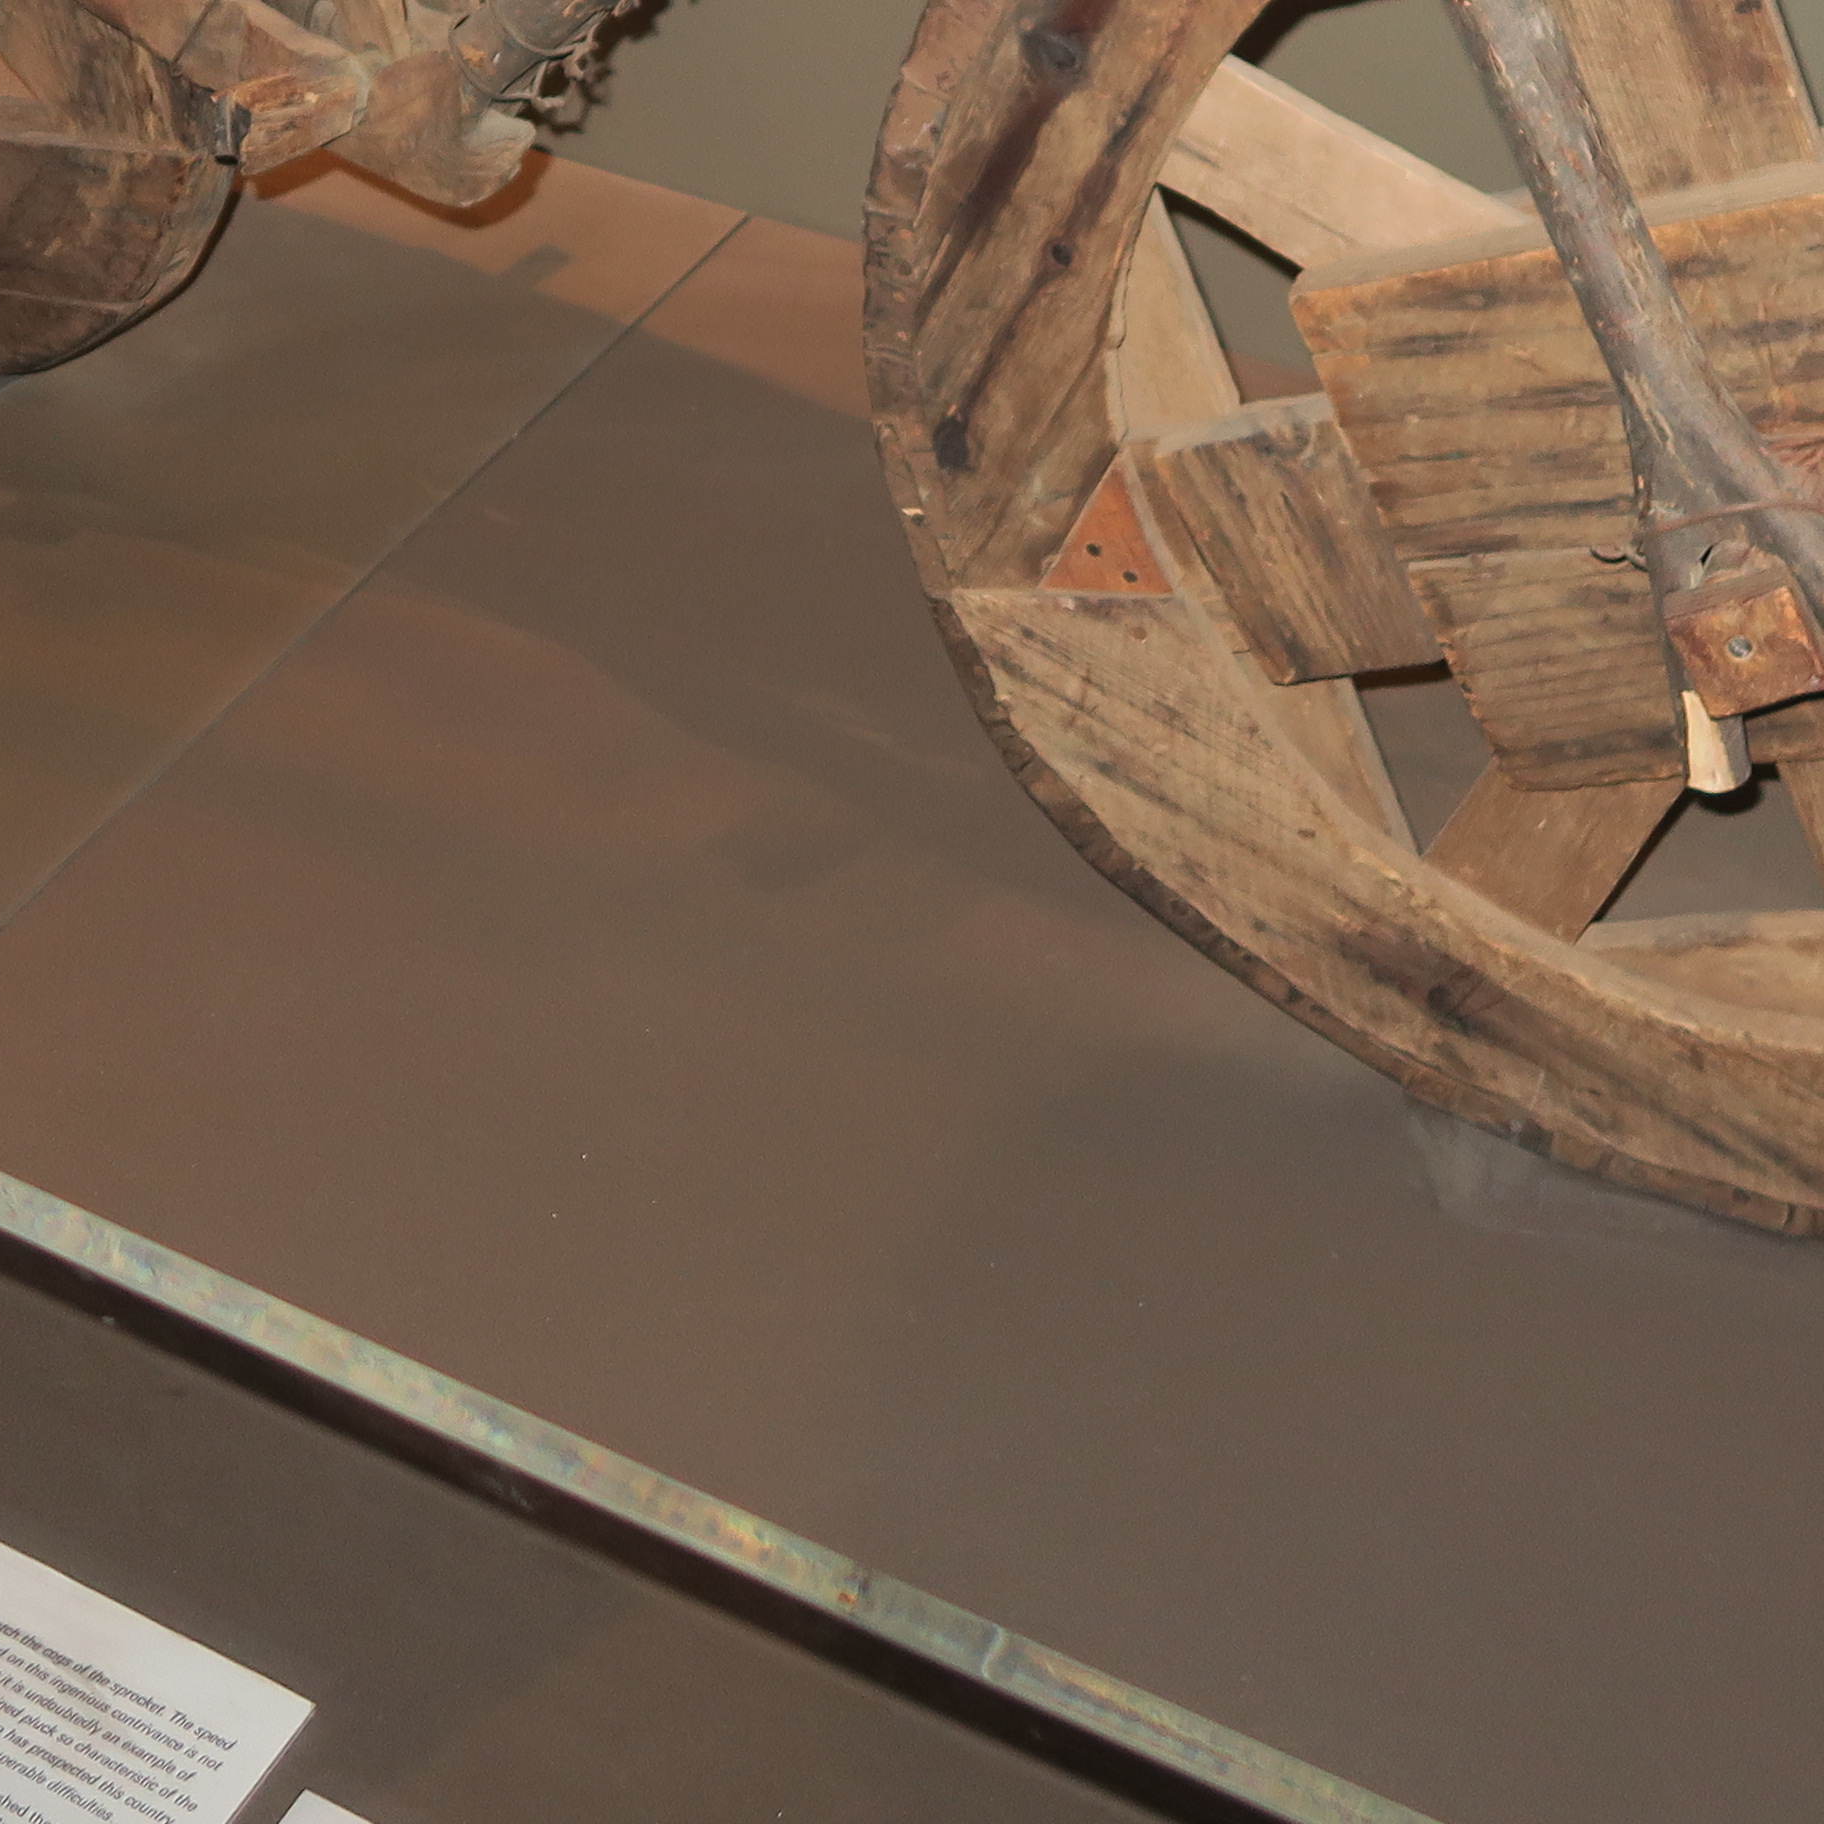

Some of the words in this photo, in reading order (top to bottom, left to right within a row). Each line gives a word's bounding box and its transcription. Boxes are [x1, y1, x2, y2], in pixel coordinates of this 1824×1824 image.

[5, 1654, 24, 1667] on
[23, 1662, 49, 1681] this
[49, 1677, 110, 1712] ingenious
[110, 1709, 183, 1751] contrivance
[183, 1747, 198, 1758] is
[196, 1754, 223, 1771] not
[10, 1680, 25, 1693] is
[24, 1690, 102, 1735] undoubtedly
[101, 1730, 121, 1744] an
[120, 1740, 176, 1774] example
[175, 1769, 197, 1781] of
[18, 1634, 43, 1651] the
[41, 1647, 73, 1667] cogs
[71, 1663, 92, 1675] of
[85, 1669, 111, 1686] the
[168, 1709, 194, 1730] The
[193, 1726, 237, 1751] speed
[3, 1728, 29, 1748] has
[25, 1744, 101, 1785] prospected
[97, 1780, 124, 1800] this
[18, 1714, 57, 1737] pluck
[55, 1733, 74, 1746] so
[74, 1742, 158, 1791] characteristic
[157, 1787, 178, 1799] of
[173, 1793, 198, 1812] the
